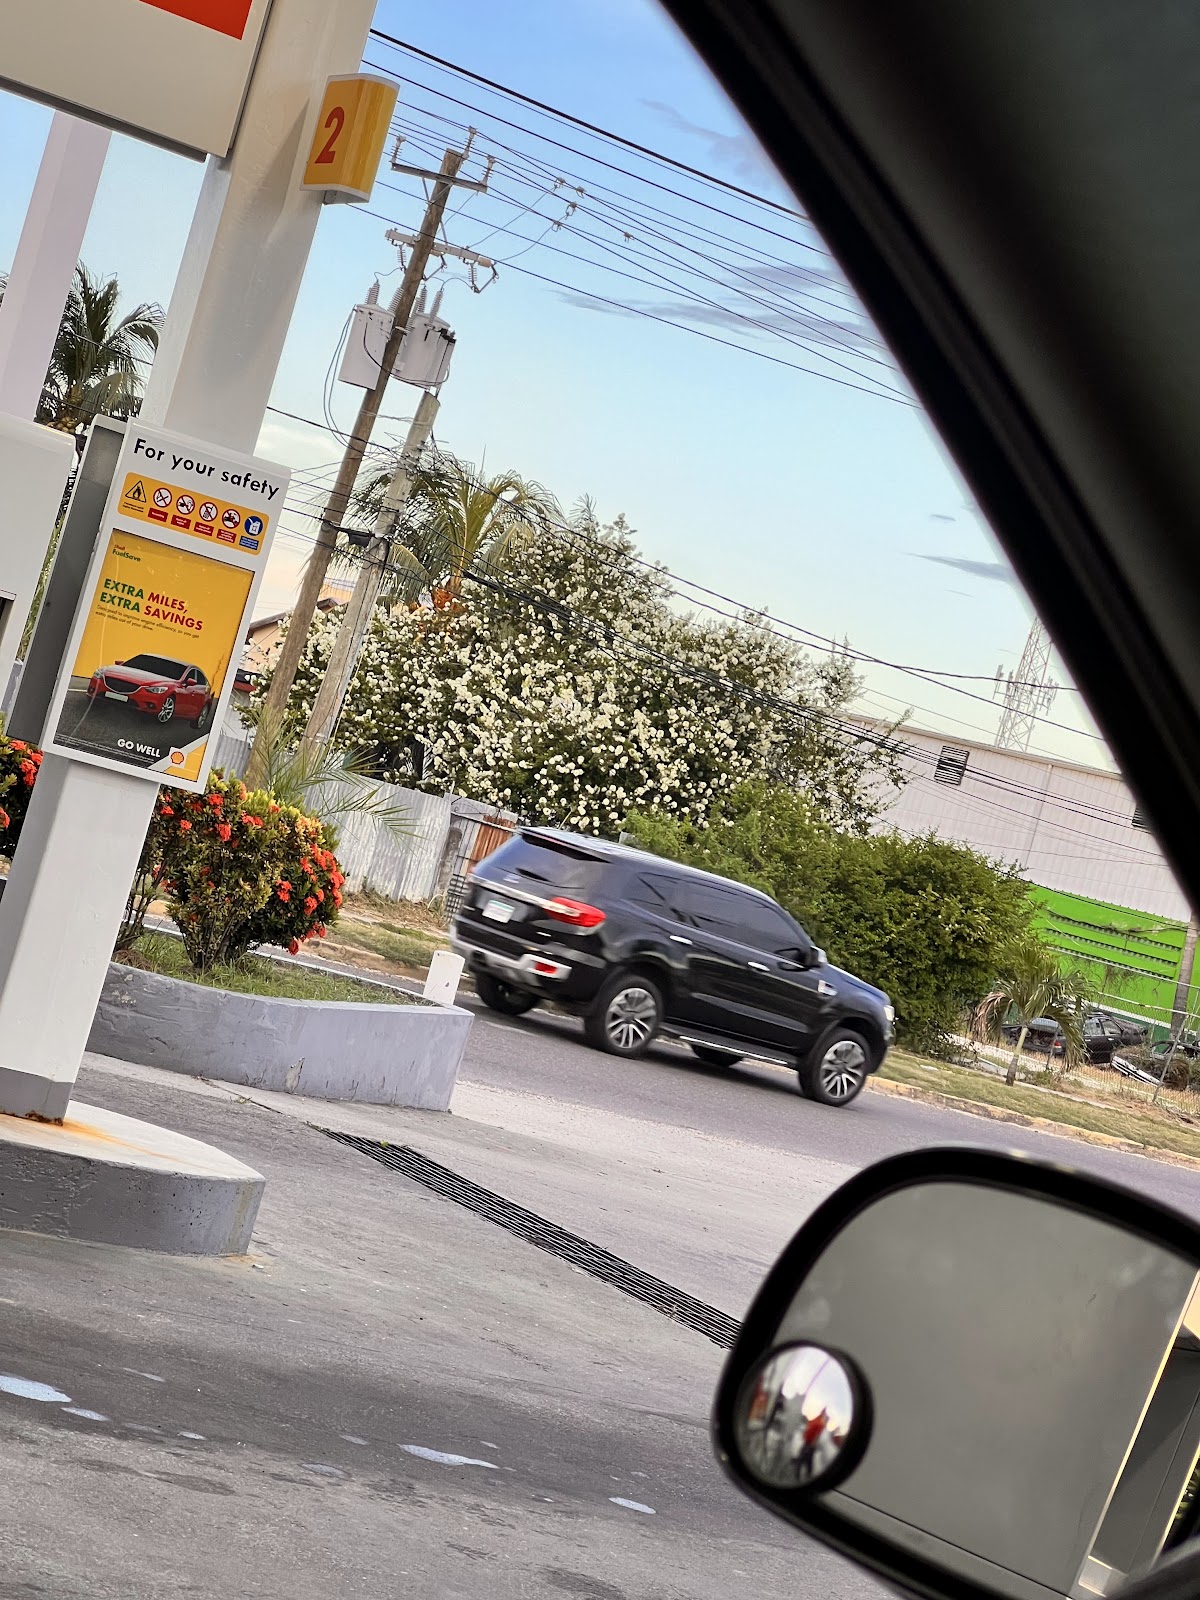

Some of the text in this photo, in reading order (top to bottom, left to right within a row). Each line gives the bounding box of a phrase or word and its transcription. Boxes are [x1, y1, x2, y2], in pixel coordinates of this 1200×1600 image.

[314, 106, 345, 164] 2
[134, 438, 279, 500] For your safety
[112, 548, 141, 562] FuelSave
[100, 591, 203, 630] EXTRA SAVINGS
[104, 578, 188, 614] EXTRA MILES,
[117, 738, 135, 750] GO
[136, 743, 161, 758] WELL
